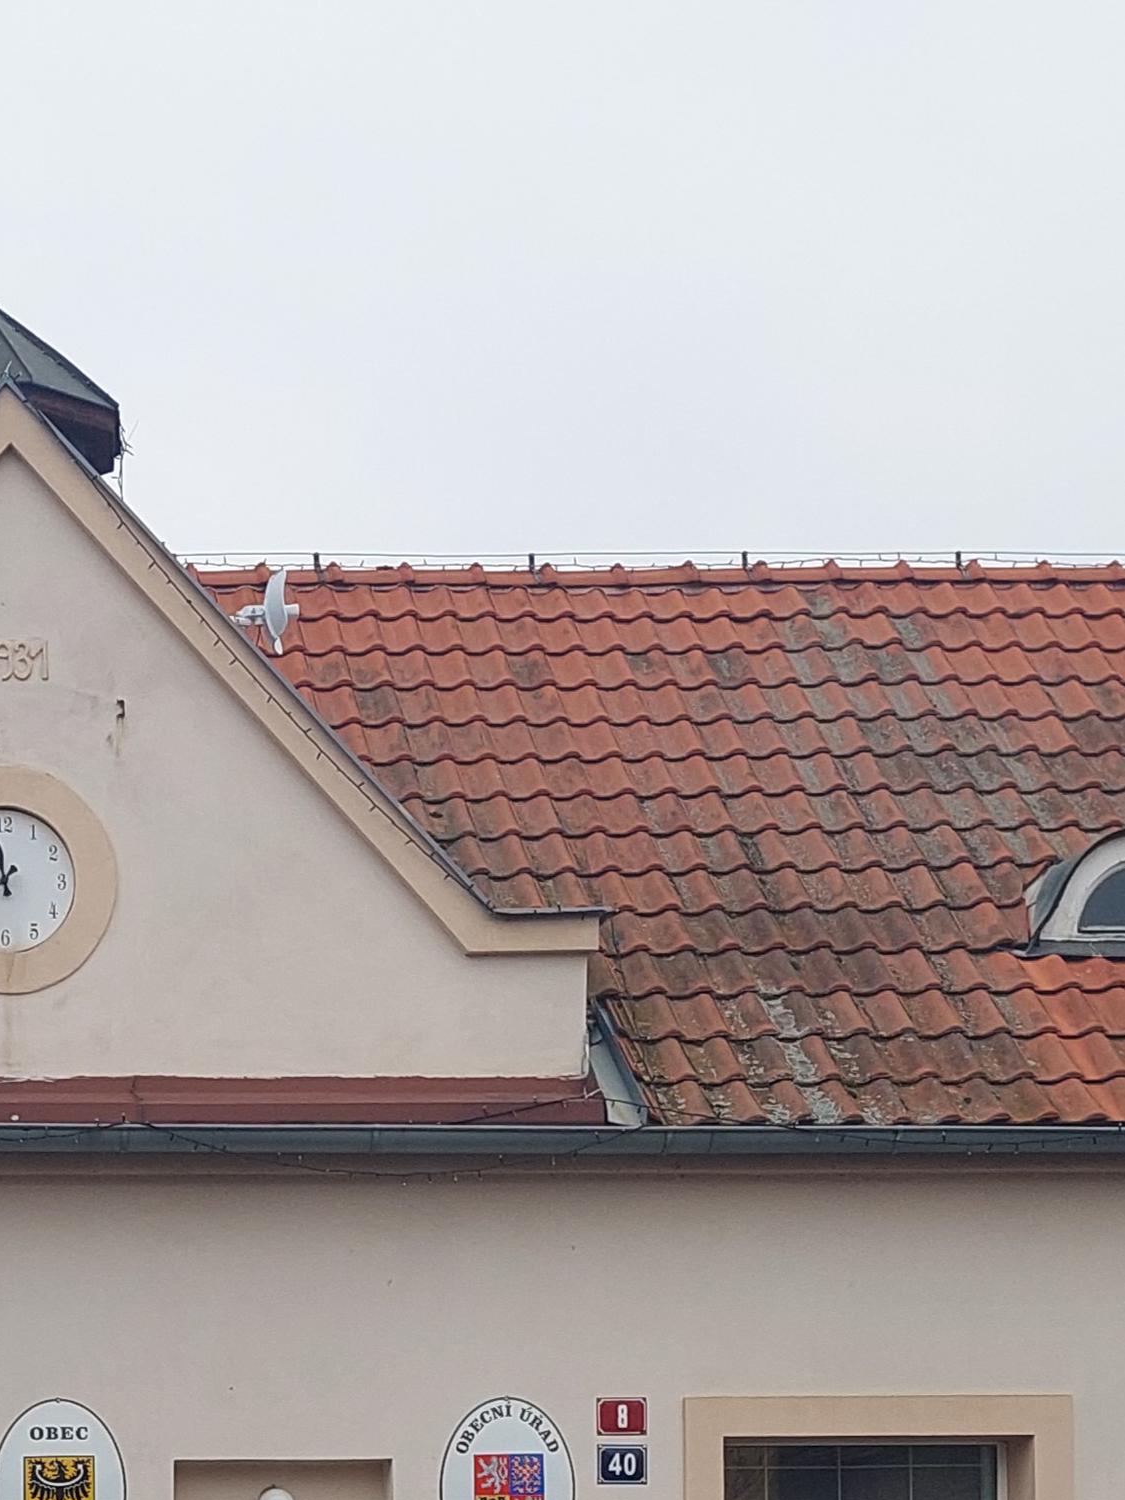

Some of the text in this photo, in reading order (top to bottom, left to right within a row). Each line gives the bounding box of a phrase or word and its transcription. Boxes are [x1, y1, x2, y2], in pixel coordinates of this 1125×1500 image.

[30, 824, 37, 840] 1
[49, 845, 58, 861] 2
[57, 873, 67, 890] 3
[49, 901, 59, 919] 4
[1, 929, 10, 946] 6
[29, 923, 39, 940] 5
[29, 1427, 89, 1440] OBEC
[455, 1400, 560, 1454] OBECNÍ ÚŘAD
[608, 1452, 636, 1476] 40
